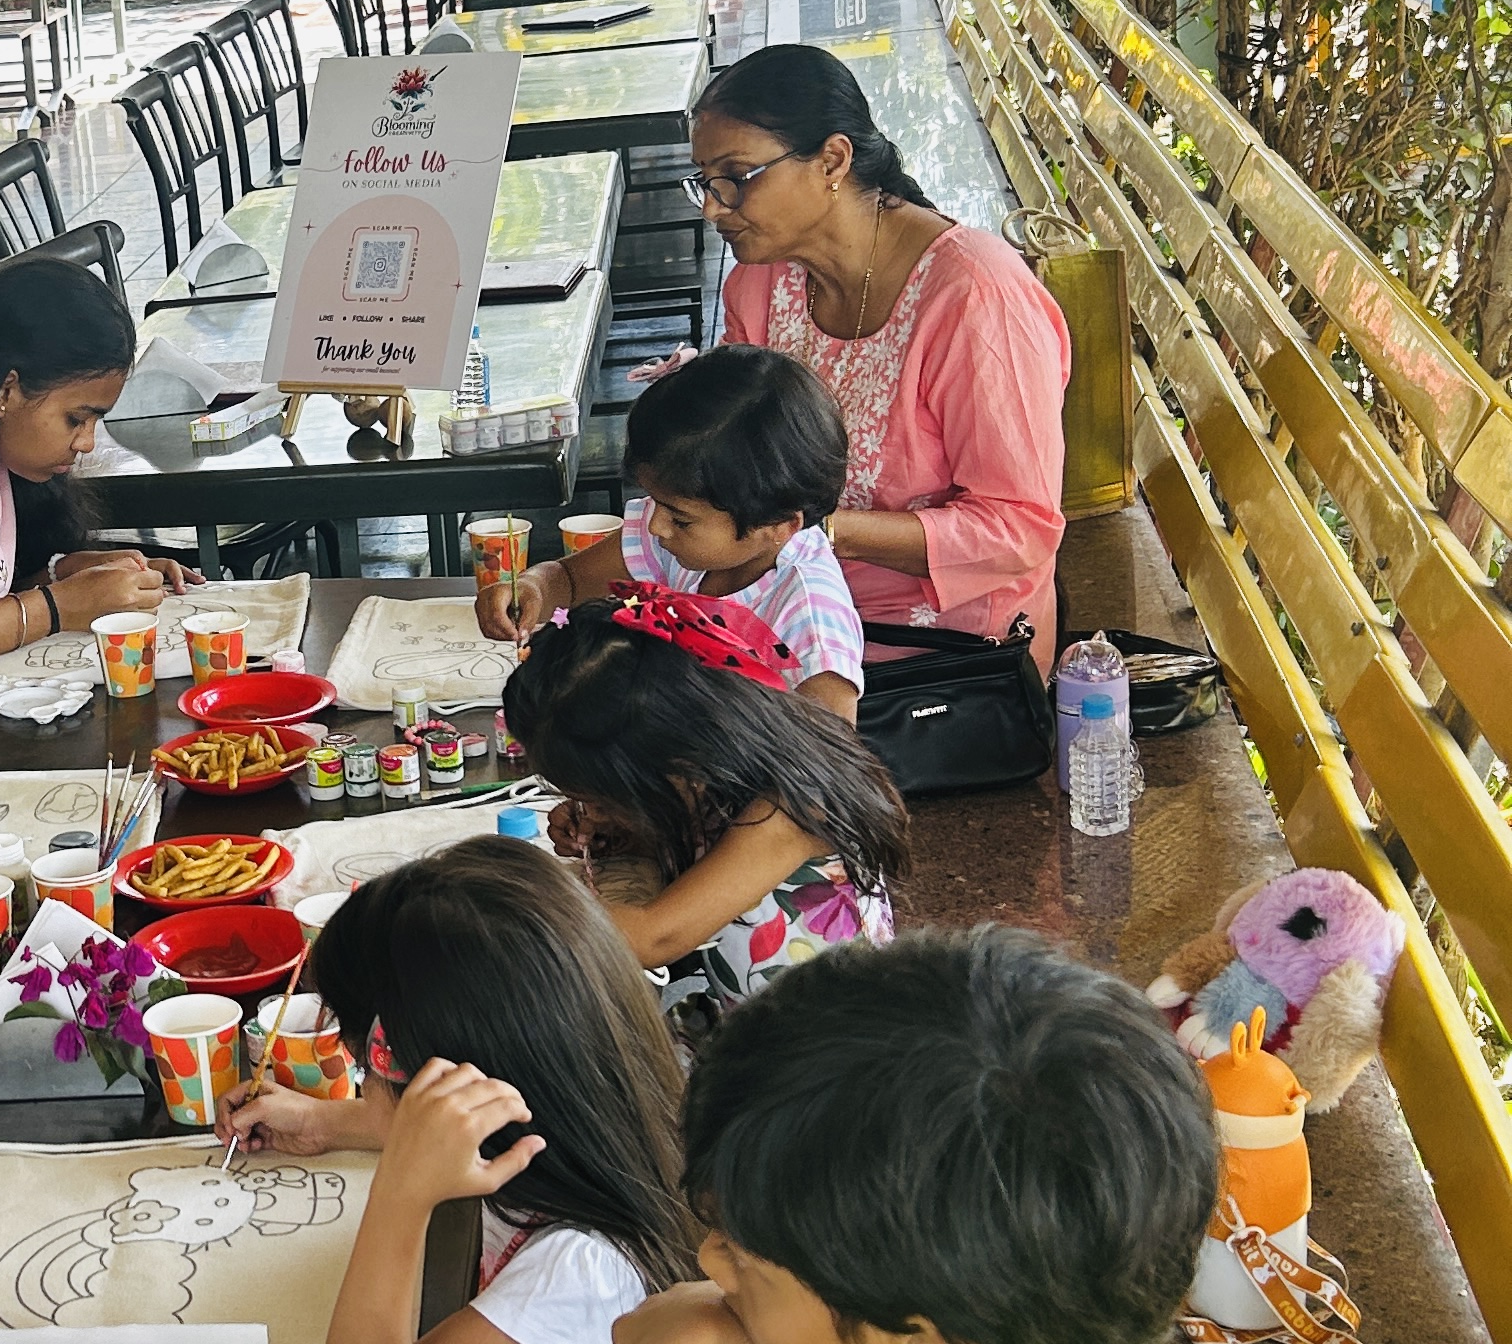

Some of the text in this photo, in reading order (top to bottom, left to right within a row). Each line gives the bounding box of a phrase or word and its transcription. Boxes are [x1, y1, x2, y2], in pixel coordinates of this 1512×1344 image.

[421, 149, 446, 173] Us
[342, 178, 442, 189] ON SOCIAL MEDIA
[352, 315, 384, 323] FOLLOW
[314, 336, 374, 361] Thank
